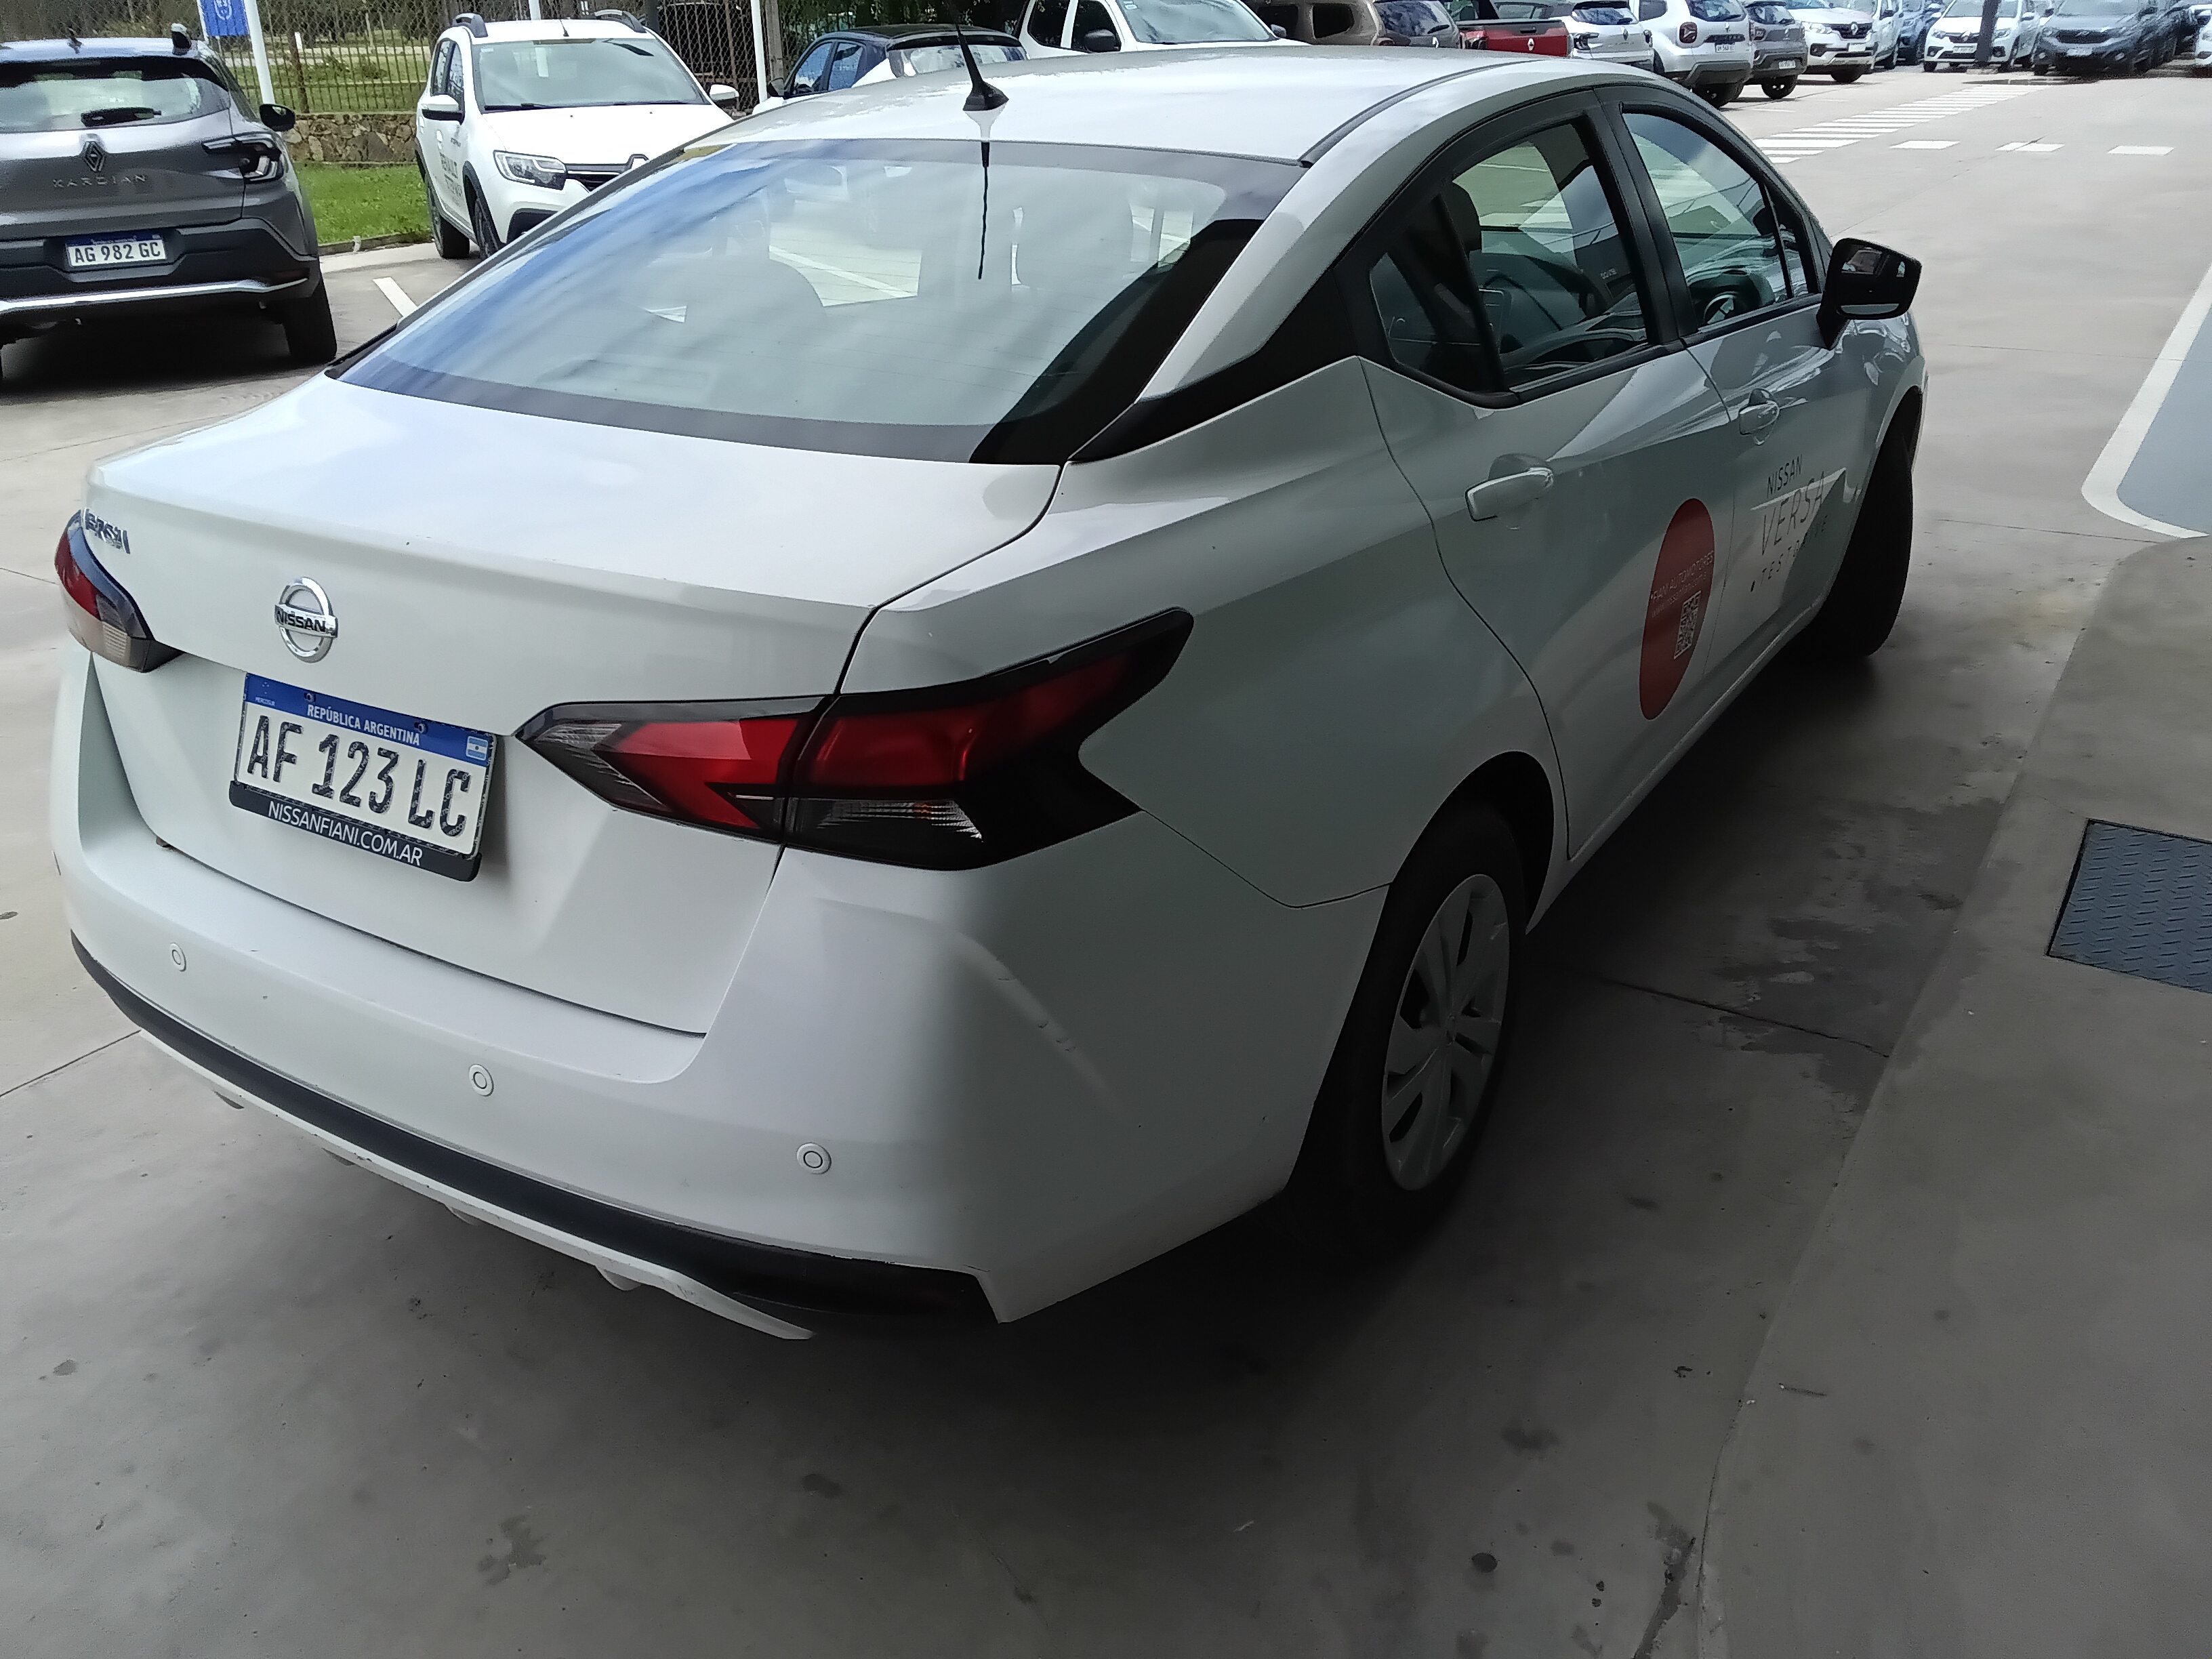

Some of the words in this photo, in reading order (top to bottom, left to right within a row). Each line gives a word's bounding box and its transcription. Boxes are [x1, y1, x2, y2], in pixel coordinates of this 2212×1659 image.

[52, 174, 148, 188] KARDIAN
[75, 247, 96, 263] AG
[101, 244, 134, 261] 982
[138, 241, 161, 258] GC
[1767, 453, 1803, 499] NISSAN
[1761, 470, 1824, 556] VERSA
[276, 610, 326, 633] NISSAN
[307, 704, 361, 730] REPÚBLICA
[363, 720, 420, 746] ARGENTINA
[247, 715, 304, 783] AF
[312, 734, 400, 814] 123
[408, 759, 472, 838] LC
[268, 800, 424, 866] NISSANFIANI.COM.AR
